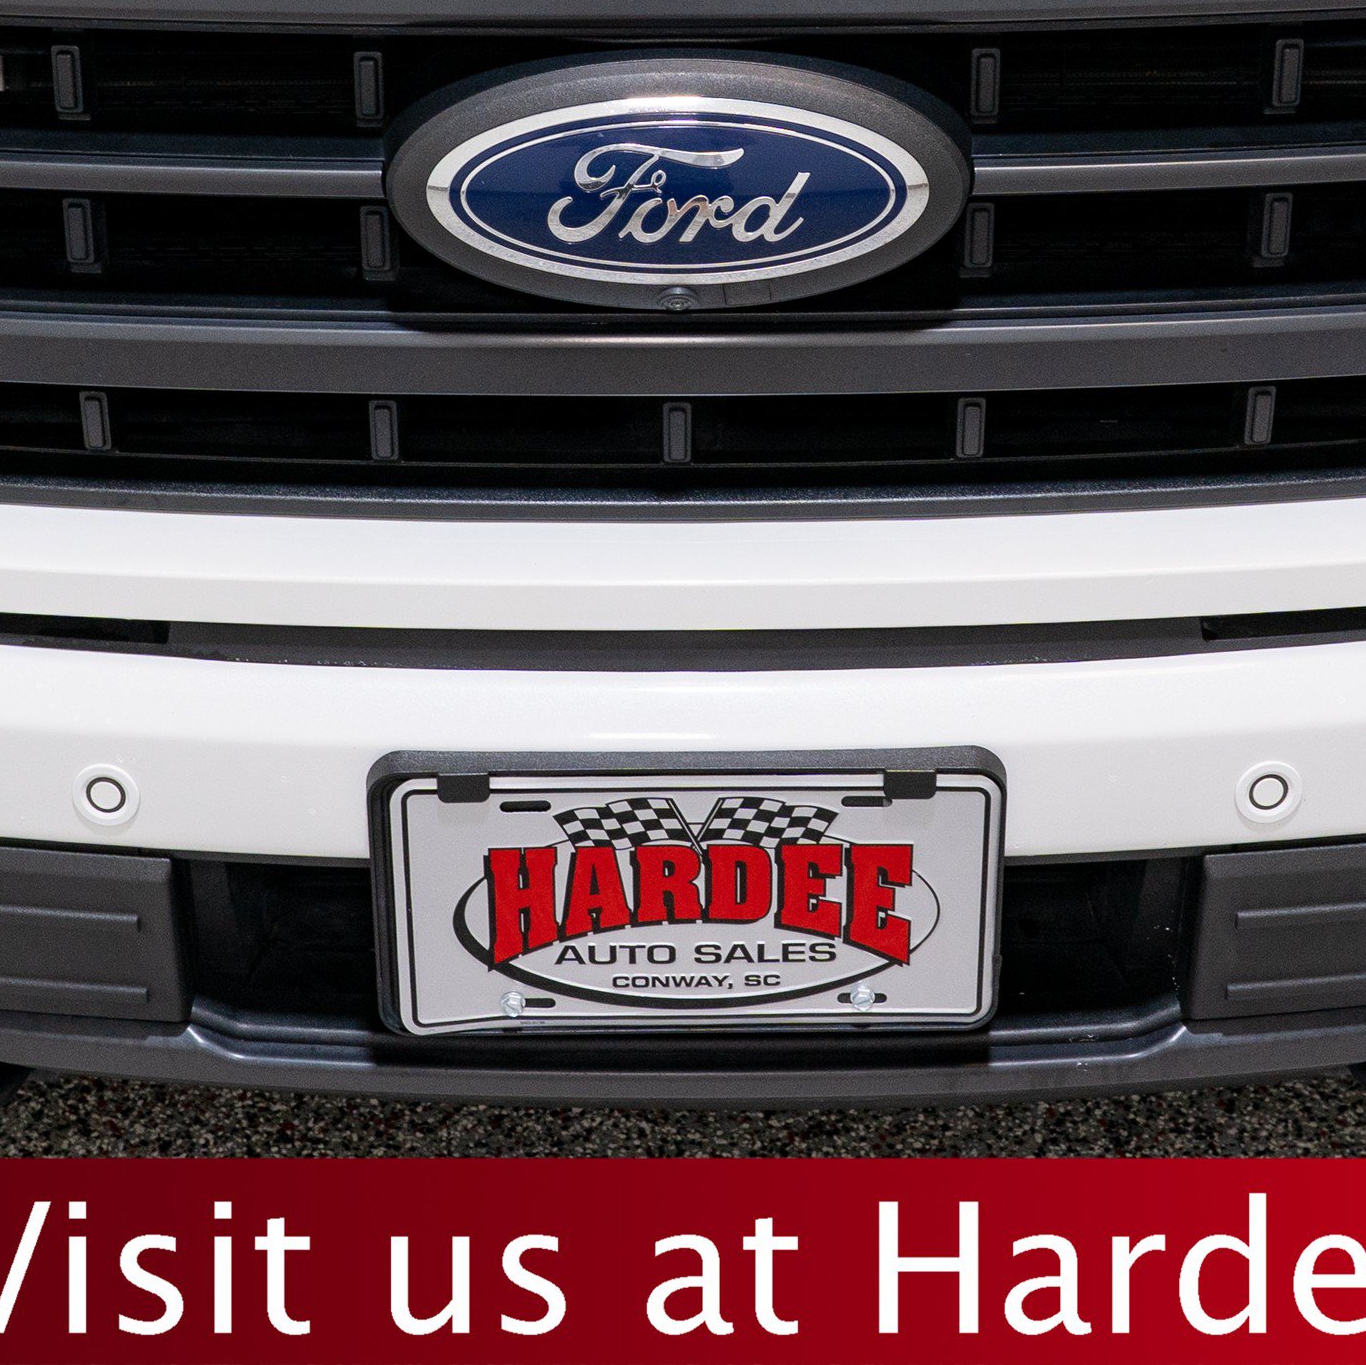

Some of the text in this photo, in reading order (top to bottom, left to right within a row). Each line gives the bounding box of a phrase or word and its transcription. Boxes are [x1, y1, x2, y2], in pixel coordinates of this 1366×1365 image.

[547, 143, 811, 242] Ford
[487, 843, 914, 969] HARDEE
[554, 942, 836, 965] AUTO SALES
[612, 974, 781, 990] CONWAY, SC
